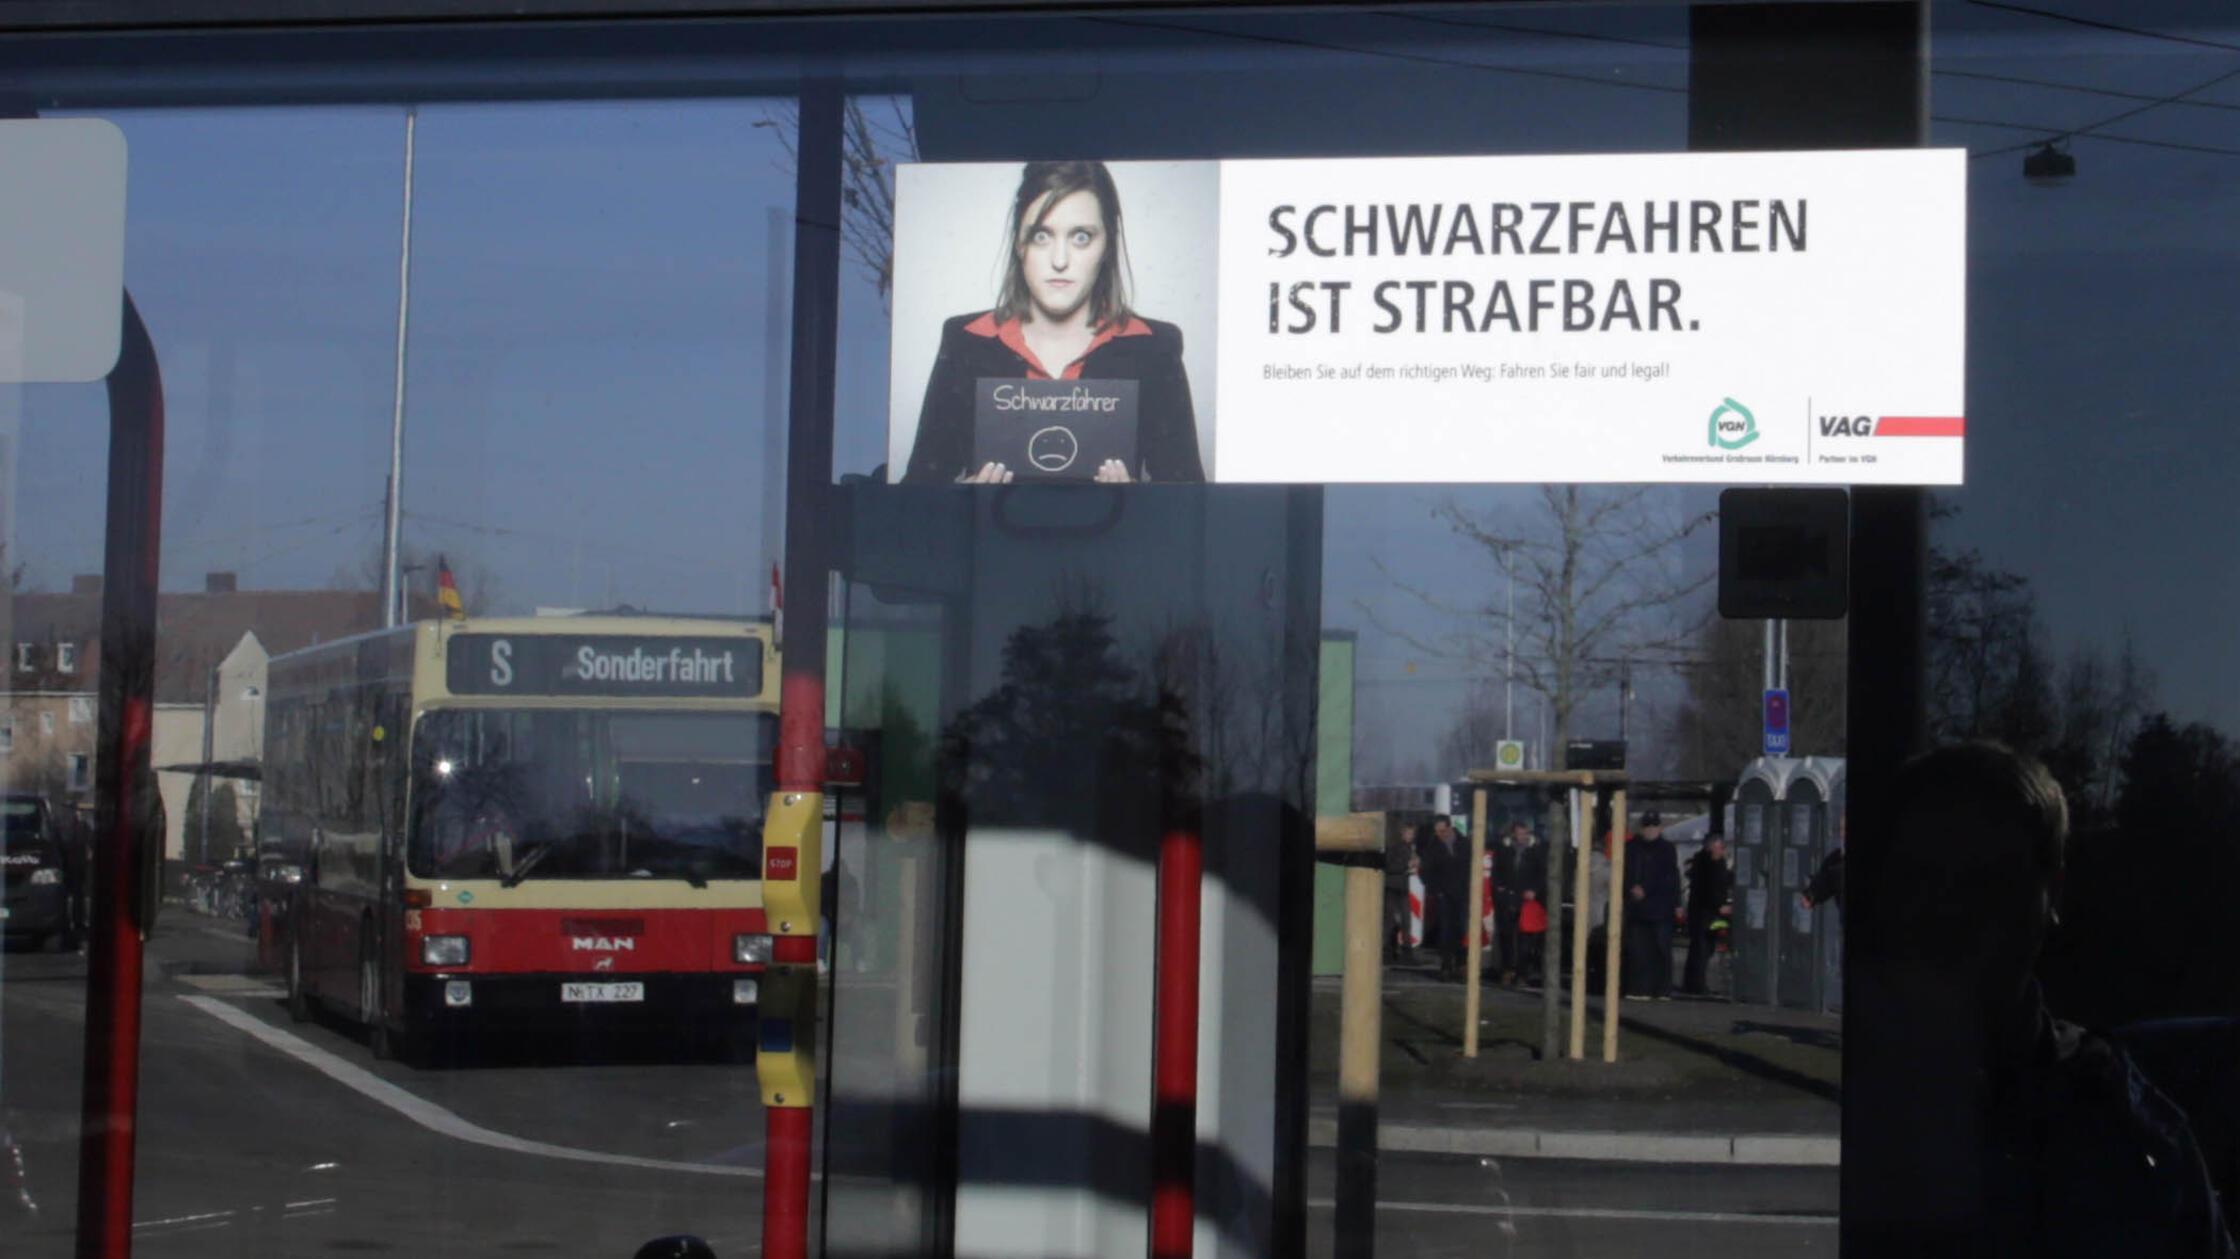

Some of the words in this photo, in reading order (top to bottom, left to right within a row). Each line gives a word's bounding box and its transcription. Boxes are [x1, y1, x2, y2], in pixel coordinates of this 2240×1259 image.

[1268, 198, 1808, 258] SCHWARZFAHREN
[1268, 279, 1352, 335] IST
[1372, 278, 1701, 335] STRAFBAR.
[1263, 363, 1312, 380] Bleiben
[1316, 363, 1336, 380] Sie
[1340, 363, 1362, 380] auf
[1366, 363, 1395, 380] dem
[1399, 363, 1458, 383] richtigen
[1461, 363, 1495, 383] Weg:
[1500, 363, 1545, 379] Fahren
[1549, 362, 1570, 379] Sie
[1573, 362, 1597, 378] fair
[1601, 362, 1628, 378] und
[1631, 361, 1670, 382] legal!
[993, 384, 1120, 412] Schwarzfahrer
[1819, 415, 1872, 437] VAG
[490, 639, 513, 687] S
[577, 646, 734, 682] Sonderfahrt
[572, 937, 635, 951] MAN
